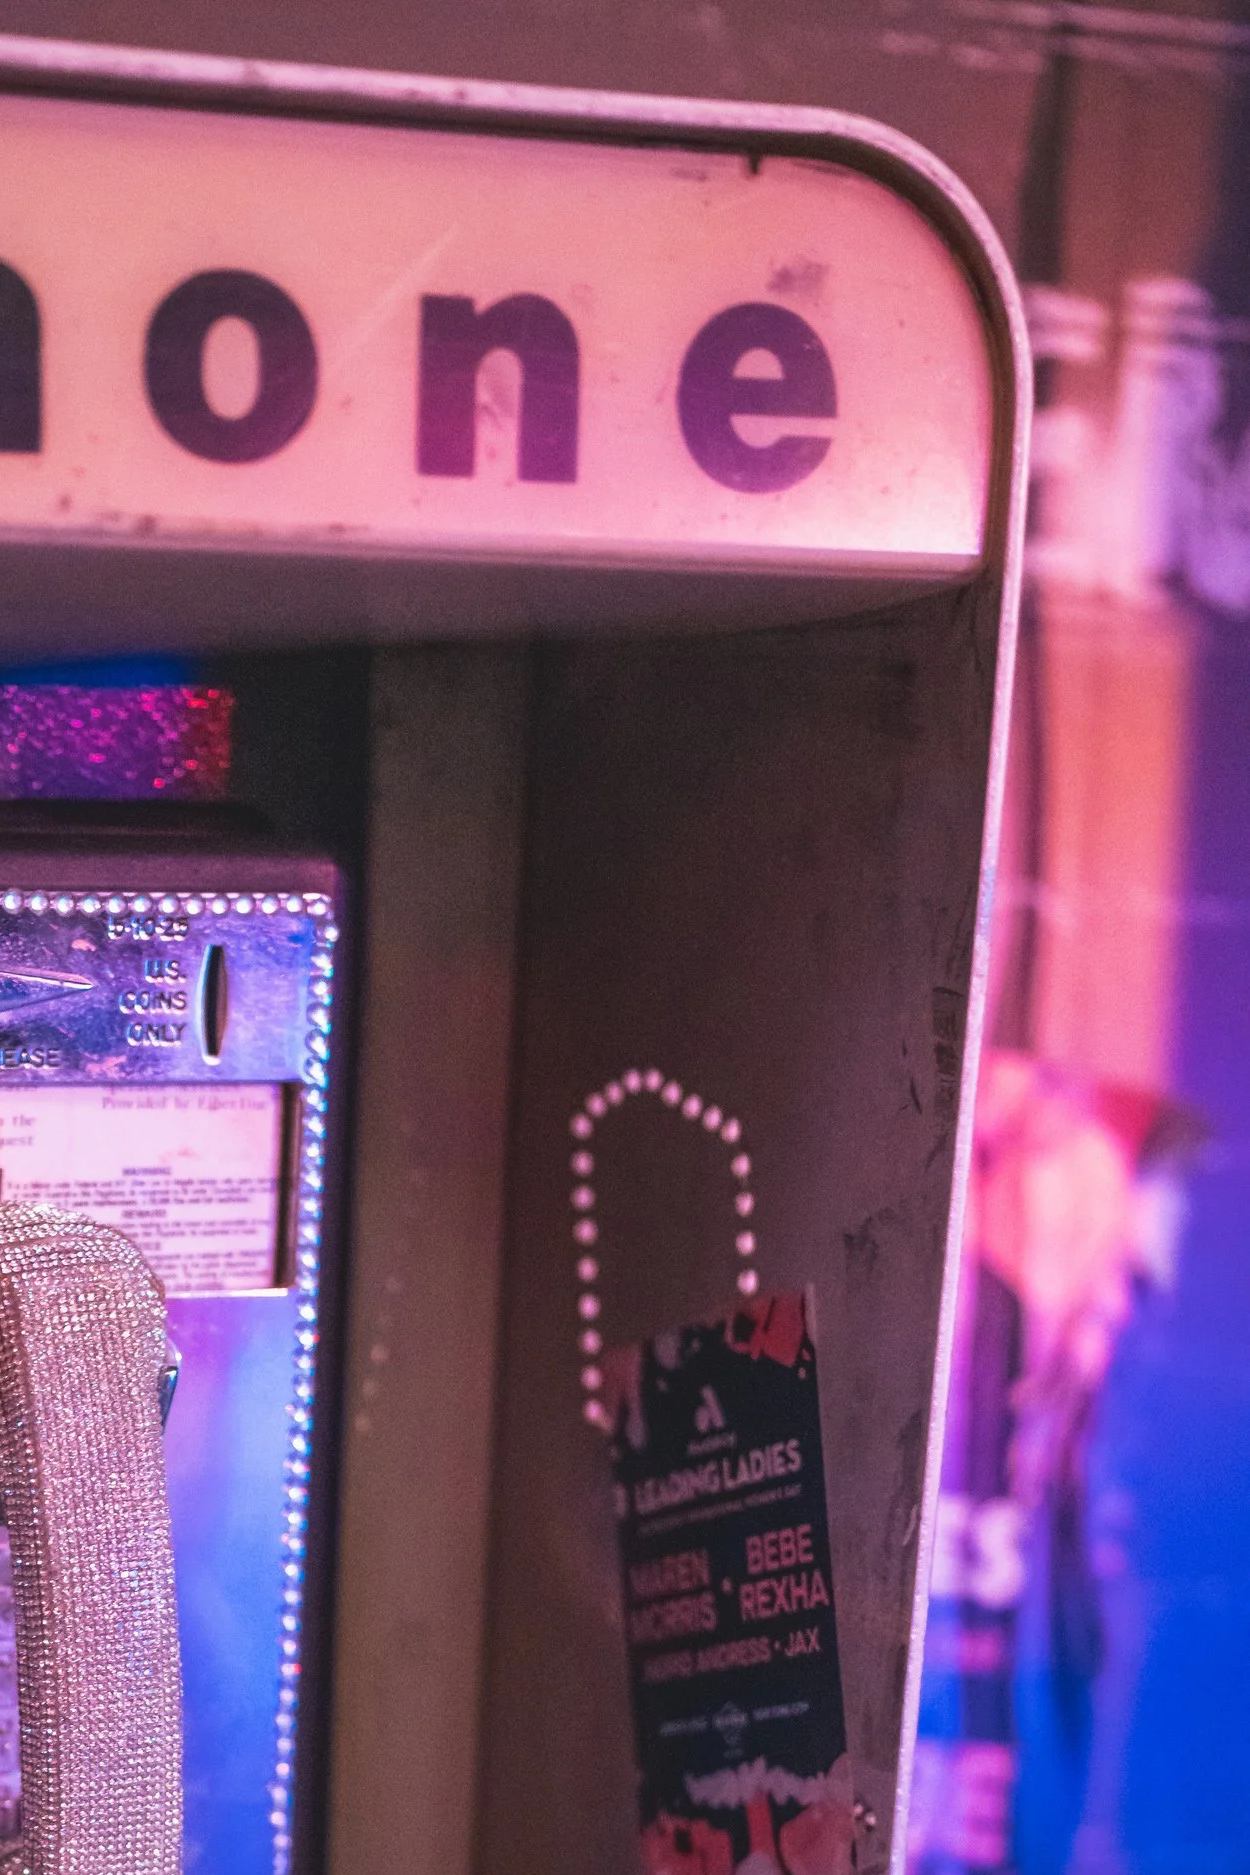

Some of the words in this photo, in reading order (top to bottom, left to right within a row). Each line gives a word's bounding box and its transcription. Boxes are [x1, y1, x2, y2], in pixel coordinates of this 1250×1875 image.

[118, 991, 187, 1014] COINS
[126, 1023, 186, 1047] ONLY
[721, 1437, 802, 1490] LADIES
[745, 1523, 815, 1576] BEBE
[739, 1568, 830, 1622] REXHA
[784, 1626, 822, 1657] JAX
